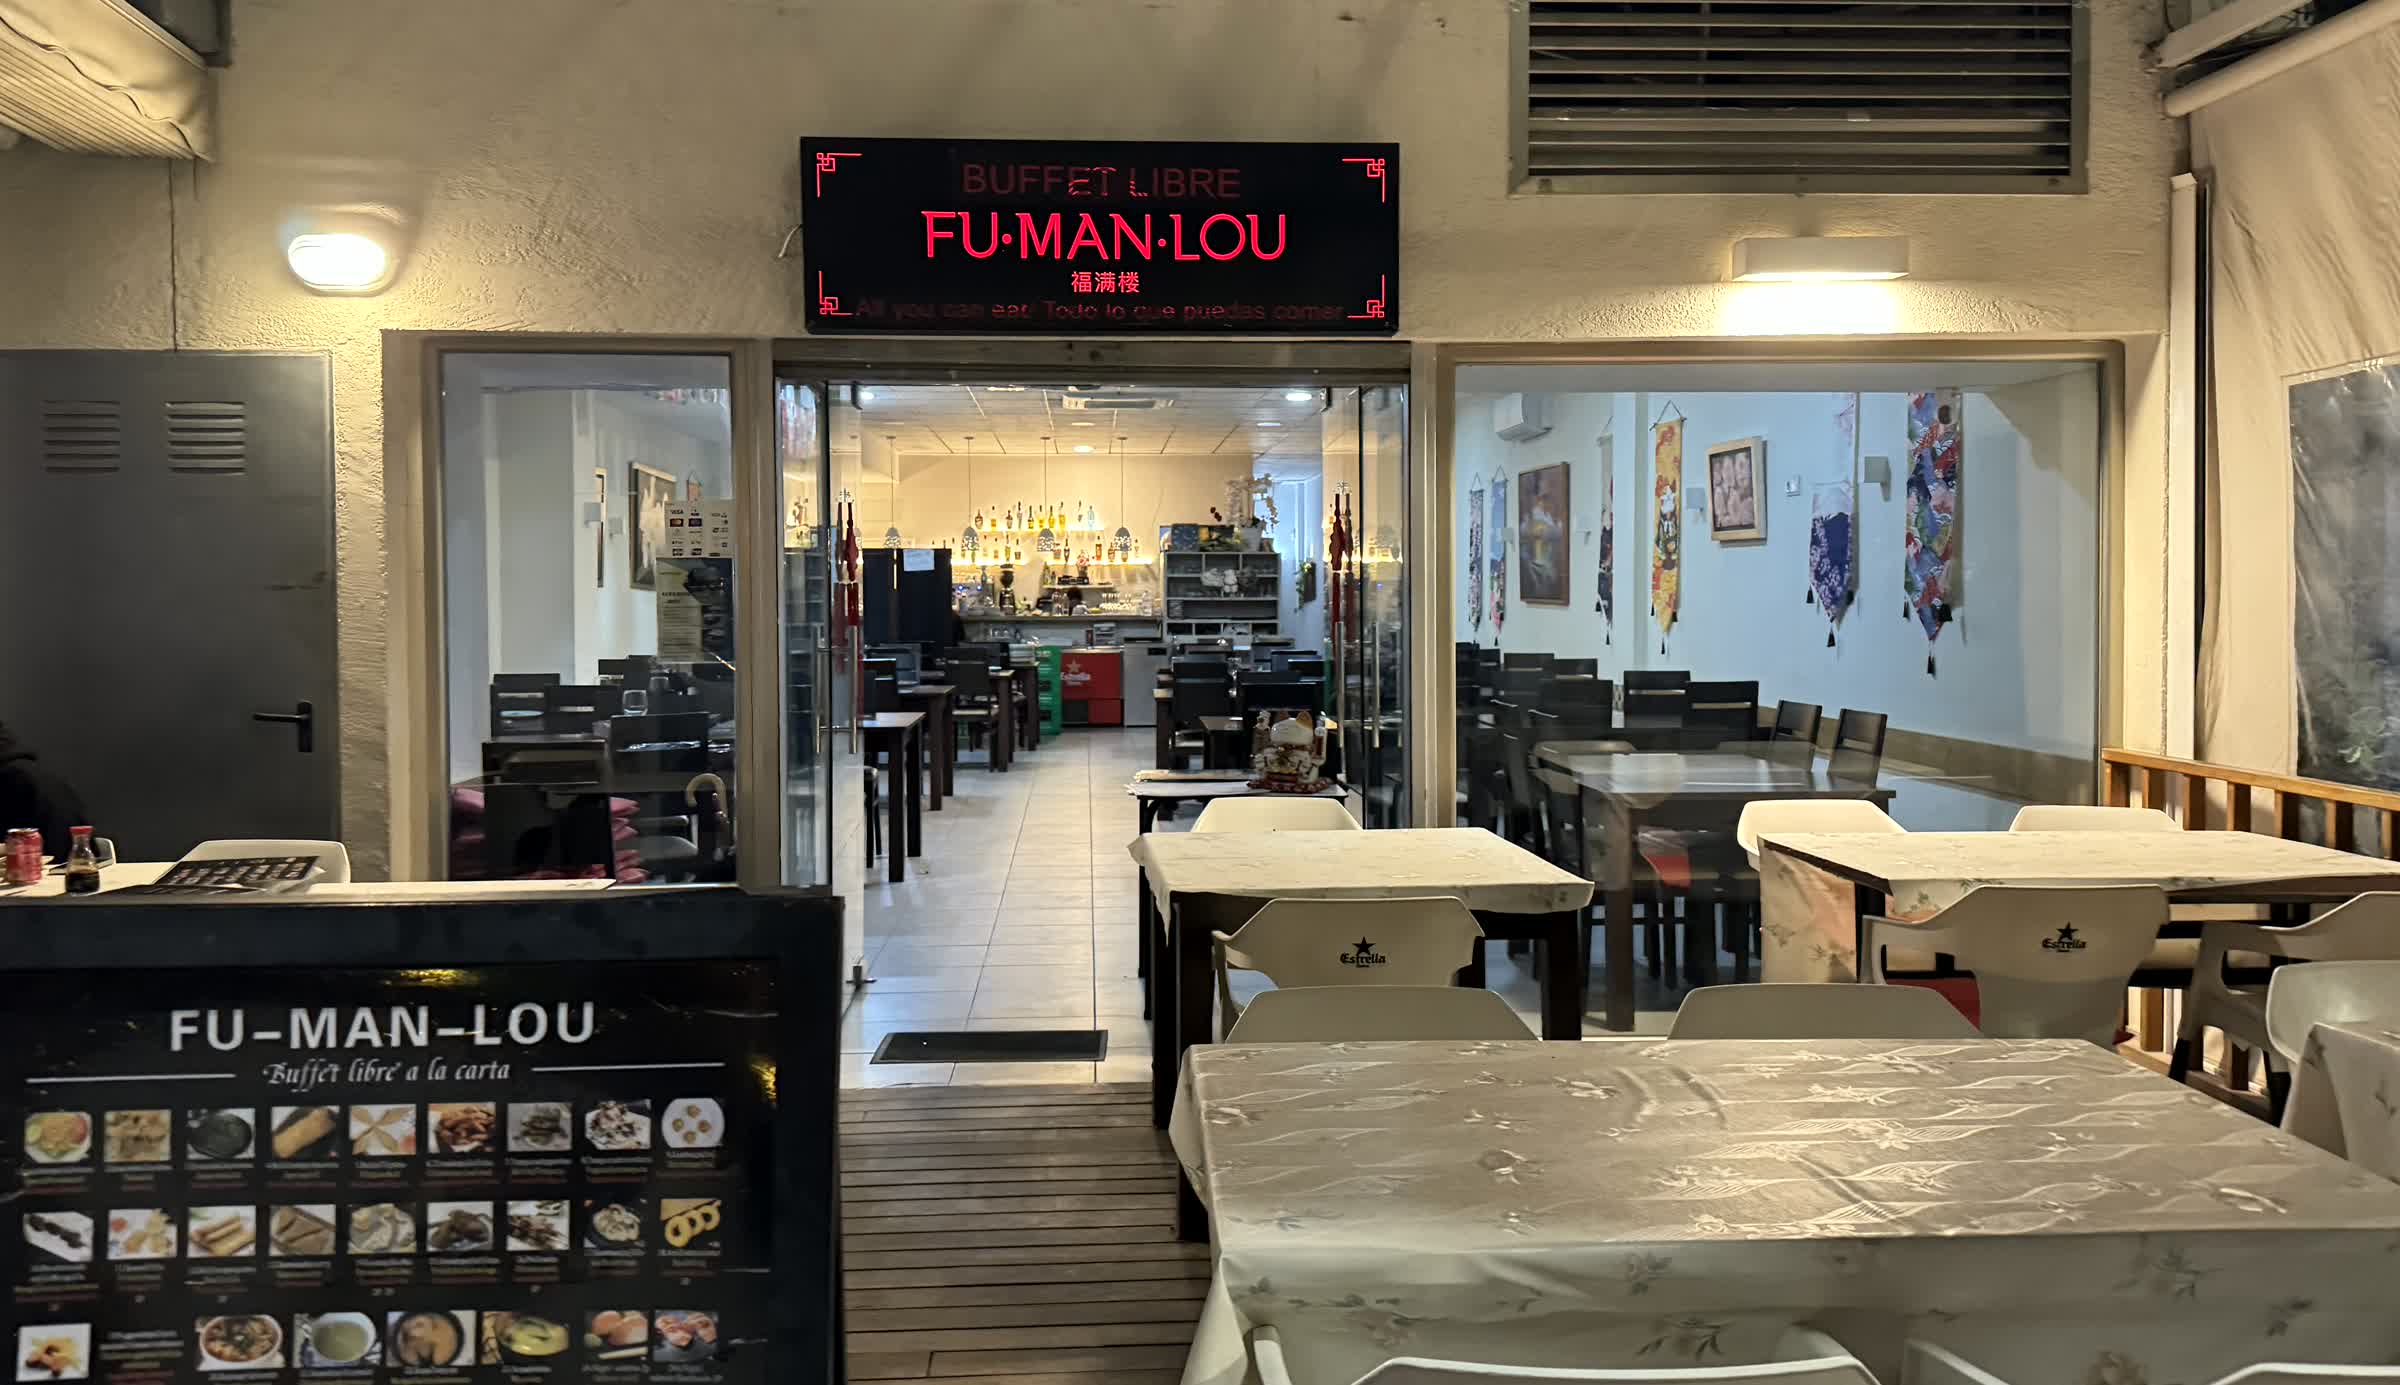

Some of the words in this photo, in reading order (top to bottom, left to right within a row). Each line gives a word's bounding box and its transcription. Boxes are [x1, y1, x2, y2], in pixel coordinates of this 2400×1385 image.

[961, 162, 1118, 198] BUFFET
[1129, 166, 1240, 199] LIBRE
[1071, 271, 1140, 293] 福满楼
[1340, 951, 1386, 965] Estrella
[262, 1058, 341, 1092] Buffet
[348, 1057, 400, 1083] libre
[405, 1064, 419, 1083] a
[427, 1057, 447, 1082] la
[455, 1060, 510, 1082] carta
